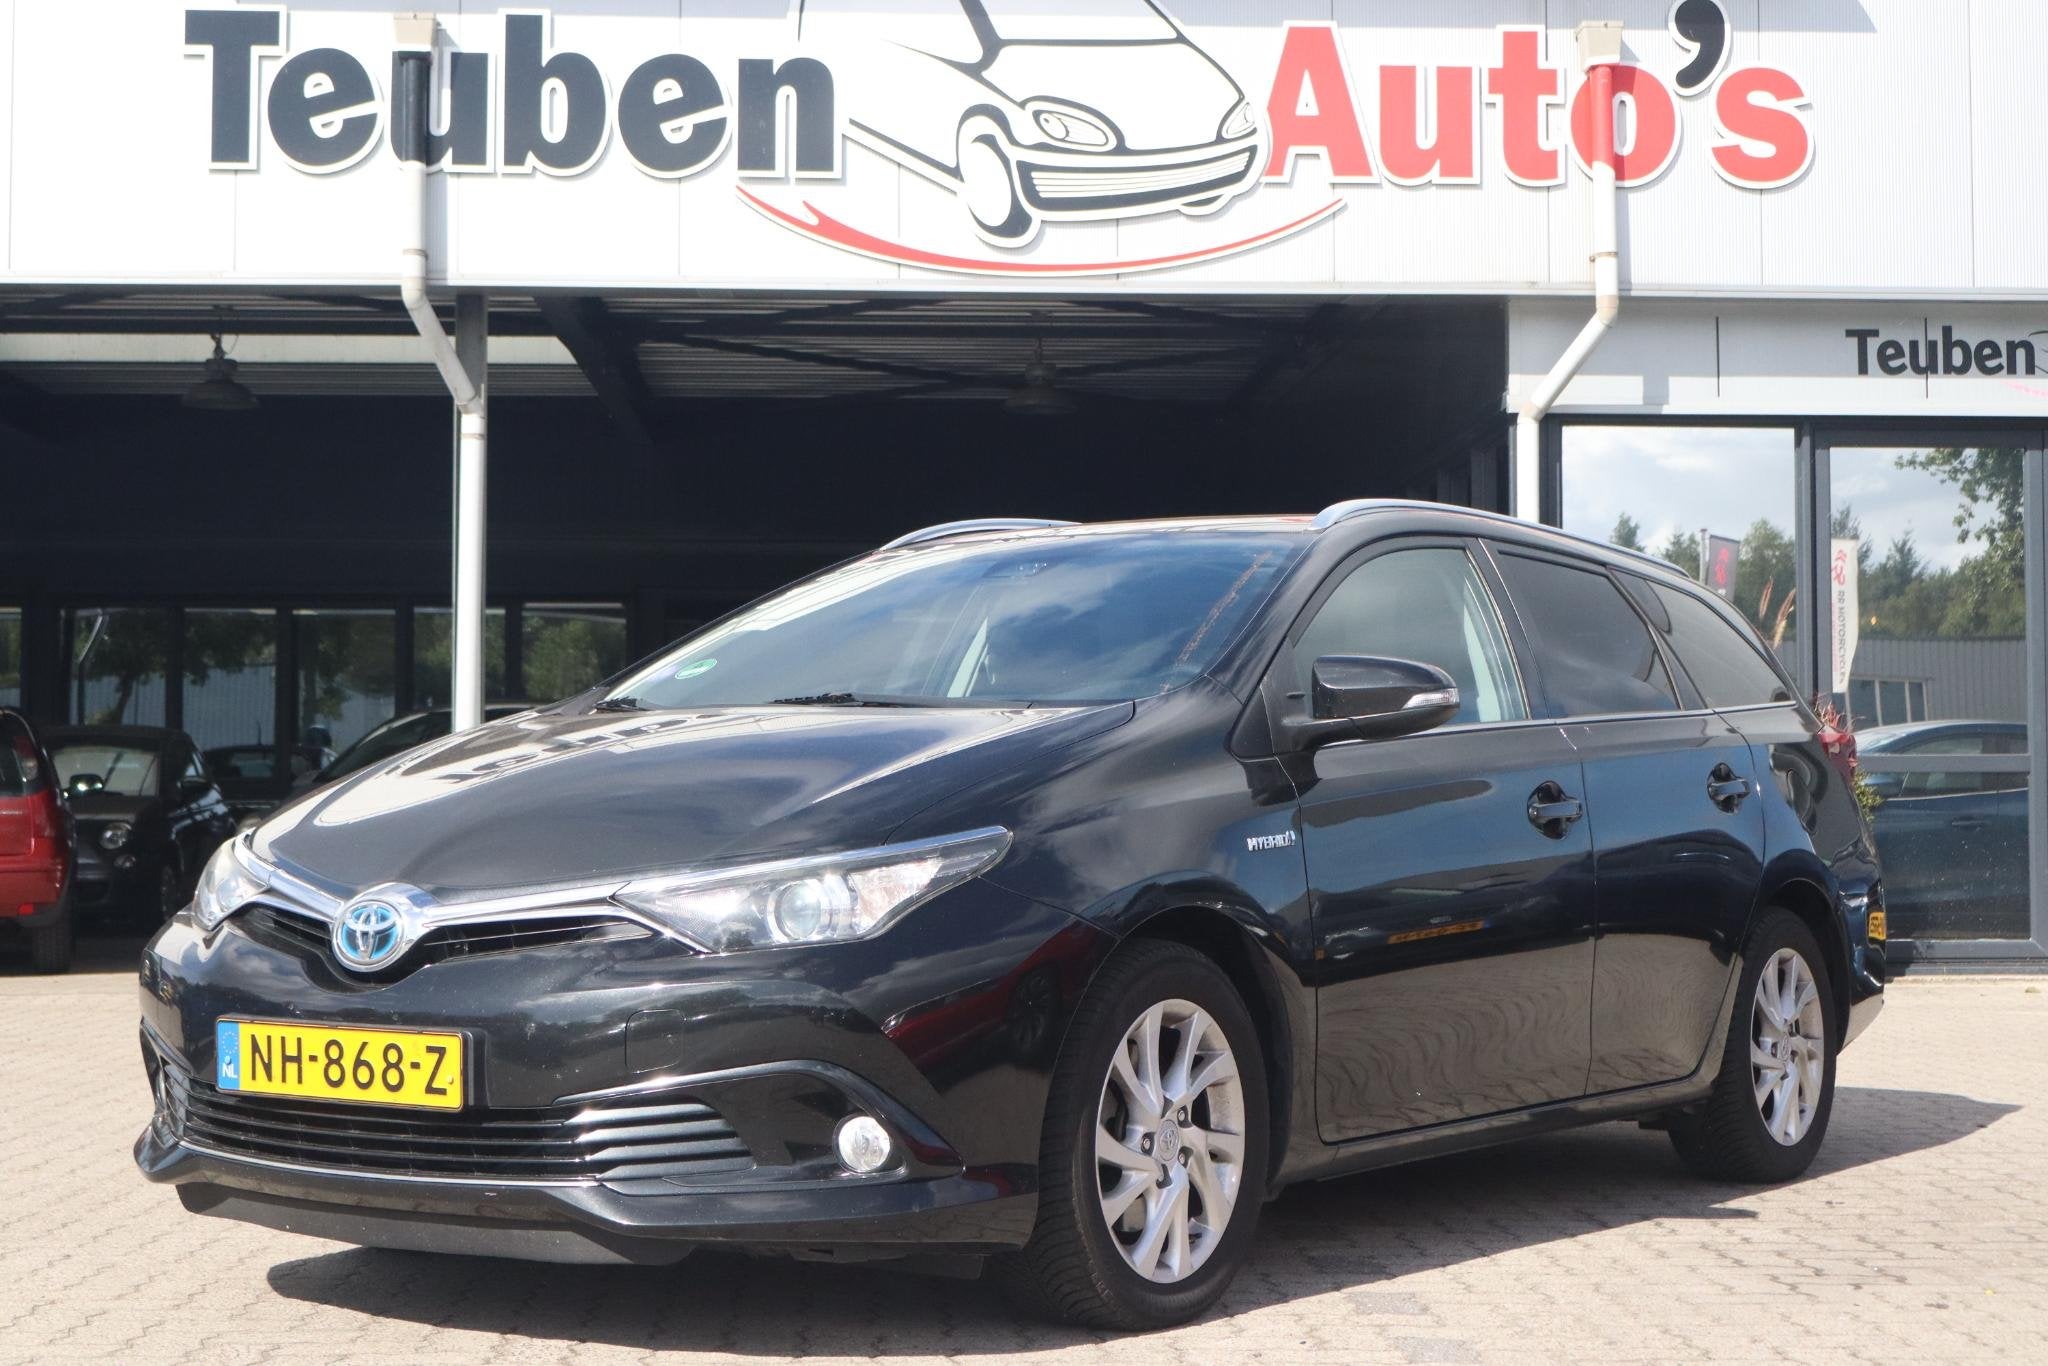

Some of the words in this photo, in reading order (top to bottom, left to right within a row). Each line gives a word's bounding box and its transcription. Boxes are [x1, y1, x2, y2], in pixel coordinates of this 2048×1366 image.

[185, 10, 835, 174] Teuben
[1268, 0, 1808, 183] Auto's
[1845, 325, 2036, 376] Teuben
[1246, 831, 1291, 852] HYBRID
[222, 1063, 238, 1079] NL
[250, 1033, 448, 1096] NH-868-Z
